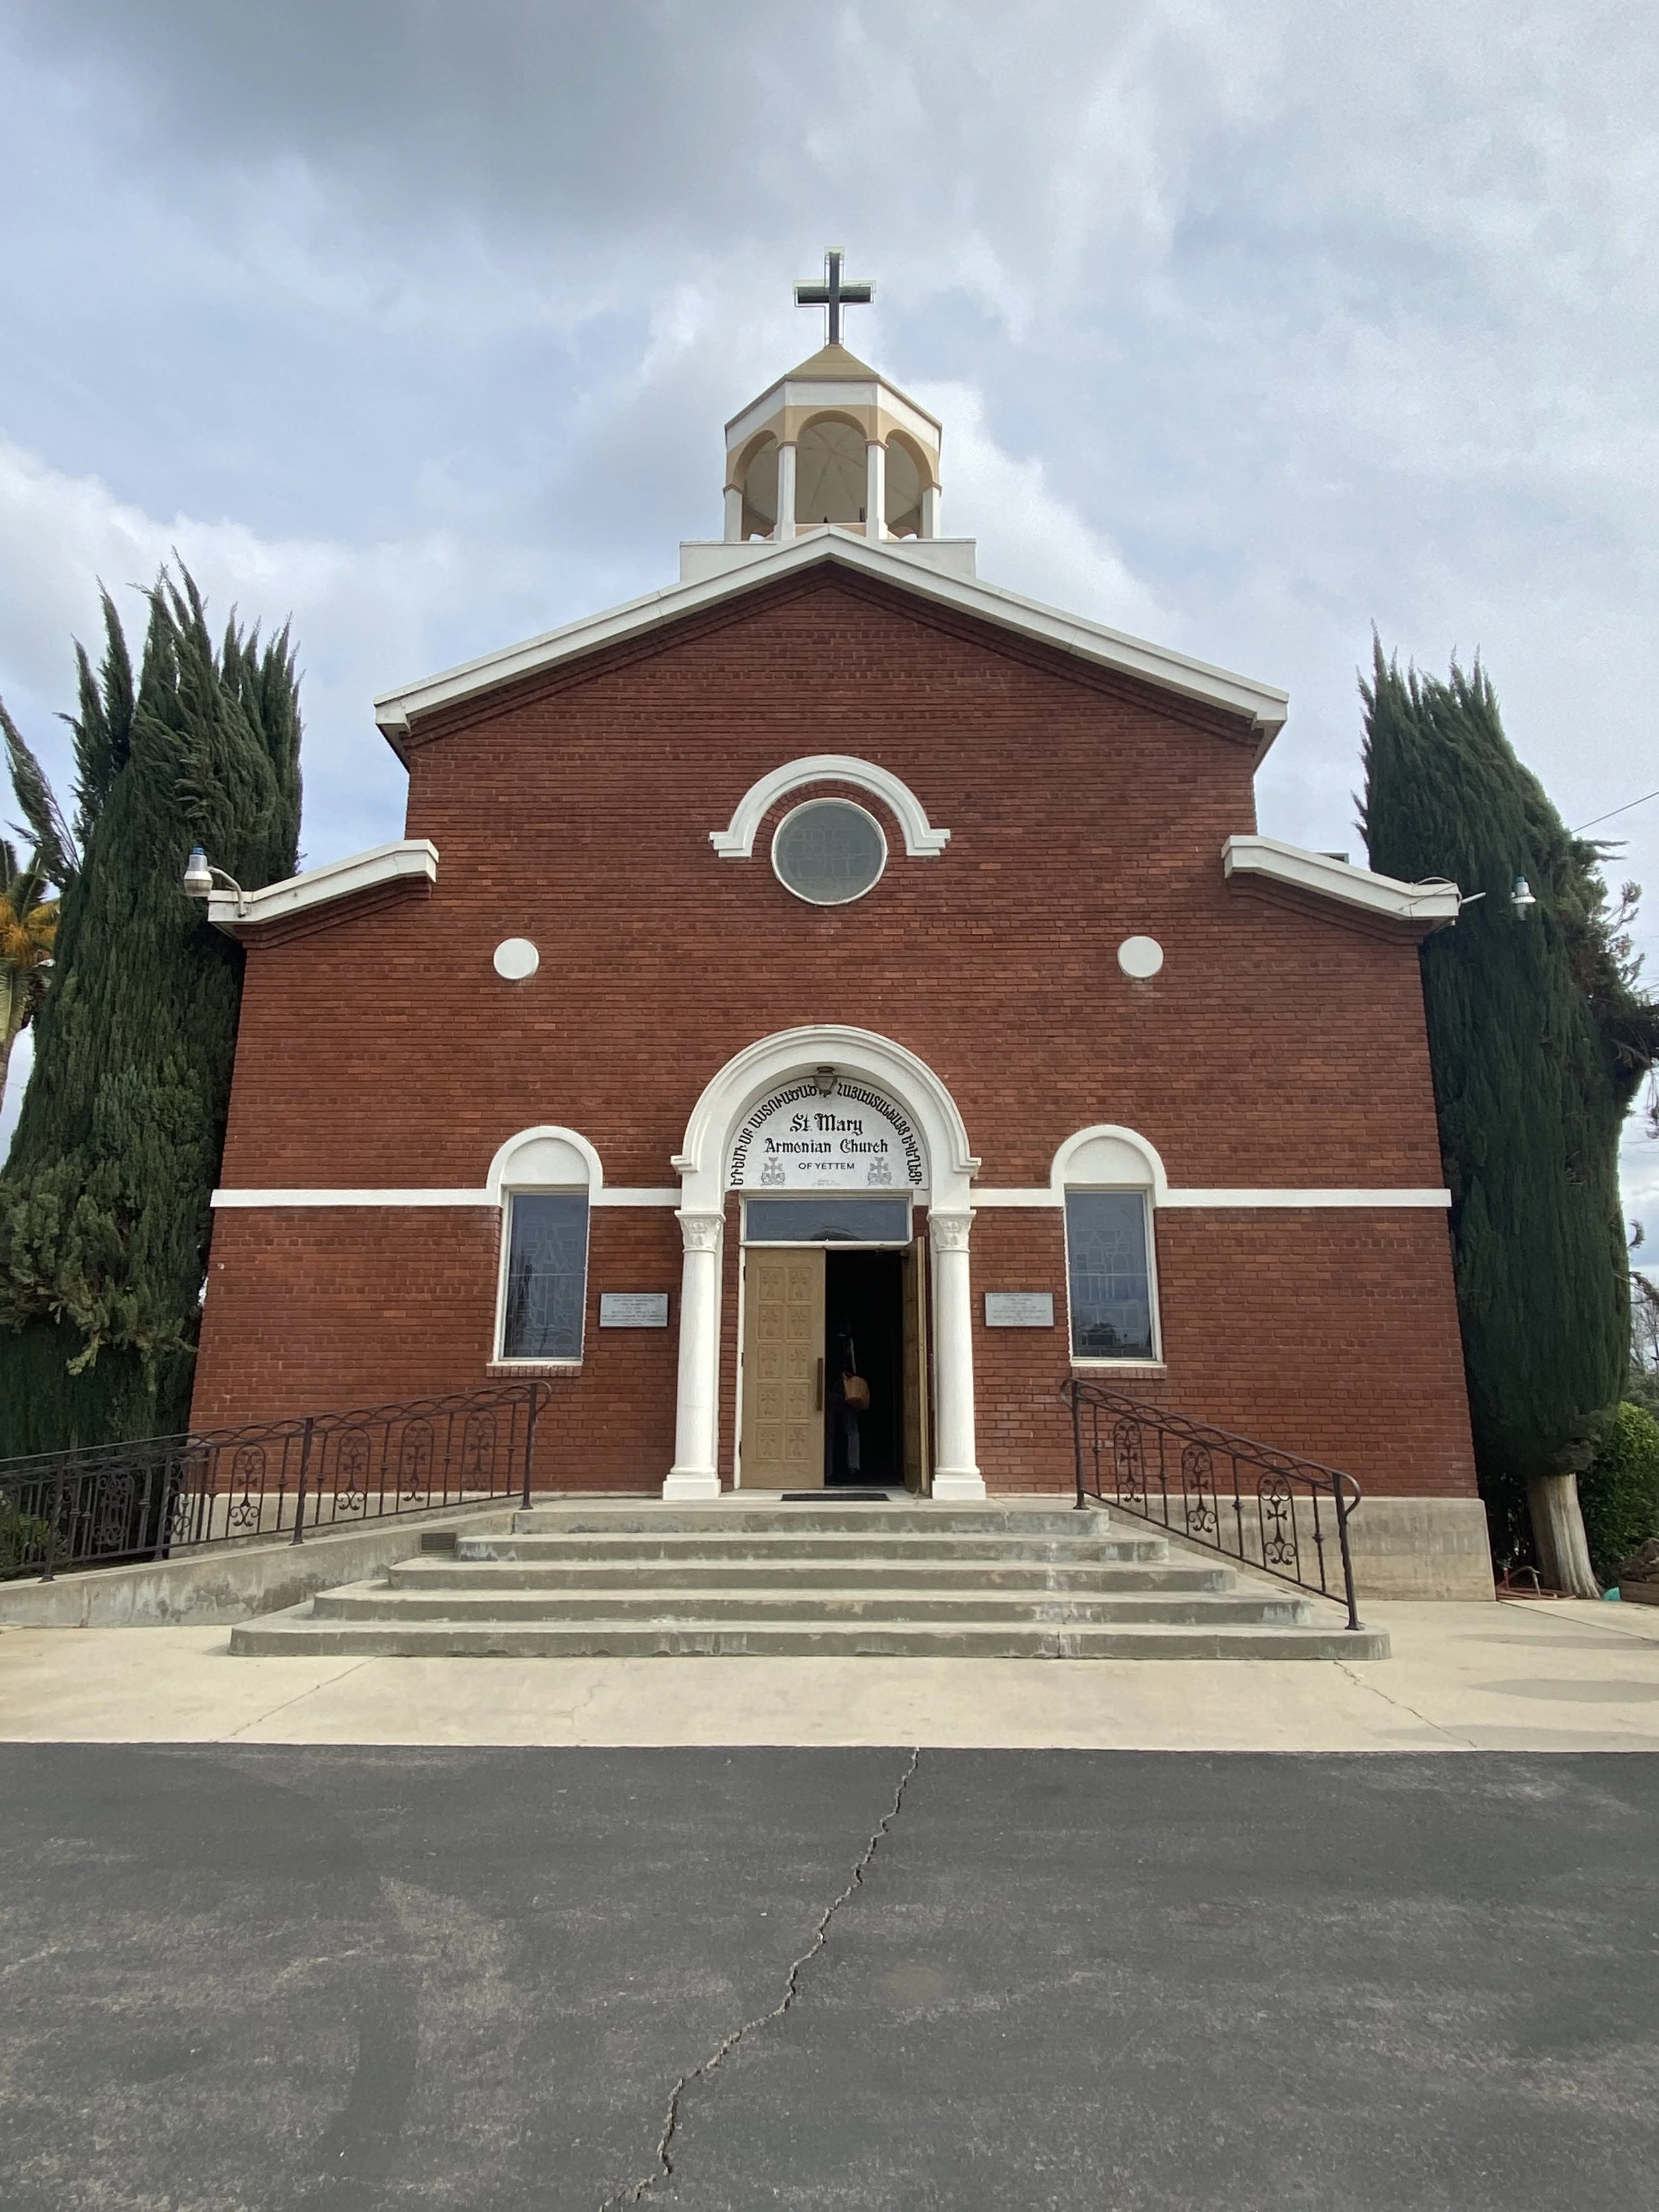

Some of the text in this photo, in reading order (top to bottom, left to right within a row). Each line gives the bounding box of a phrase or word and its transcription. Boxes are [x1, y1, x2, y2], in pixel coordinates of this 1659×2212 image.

[747, 1084, 822, 1129] ԱՍՏՈՒԱԾԱԾ
[814, 1112, 863, 1136] Mary
[764, 1138, 889, 1153] Armenian Church
